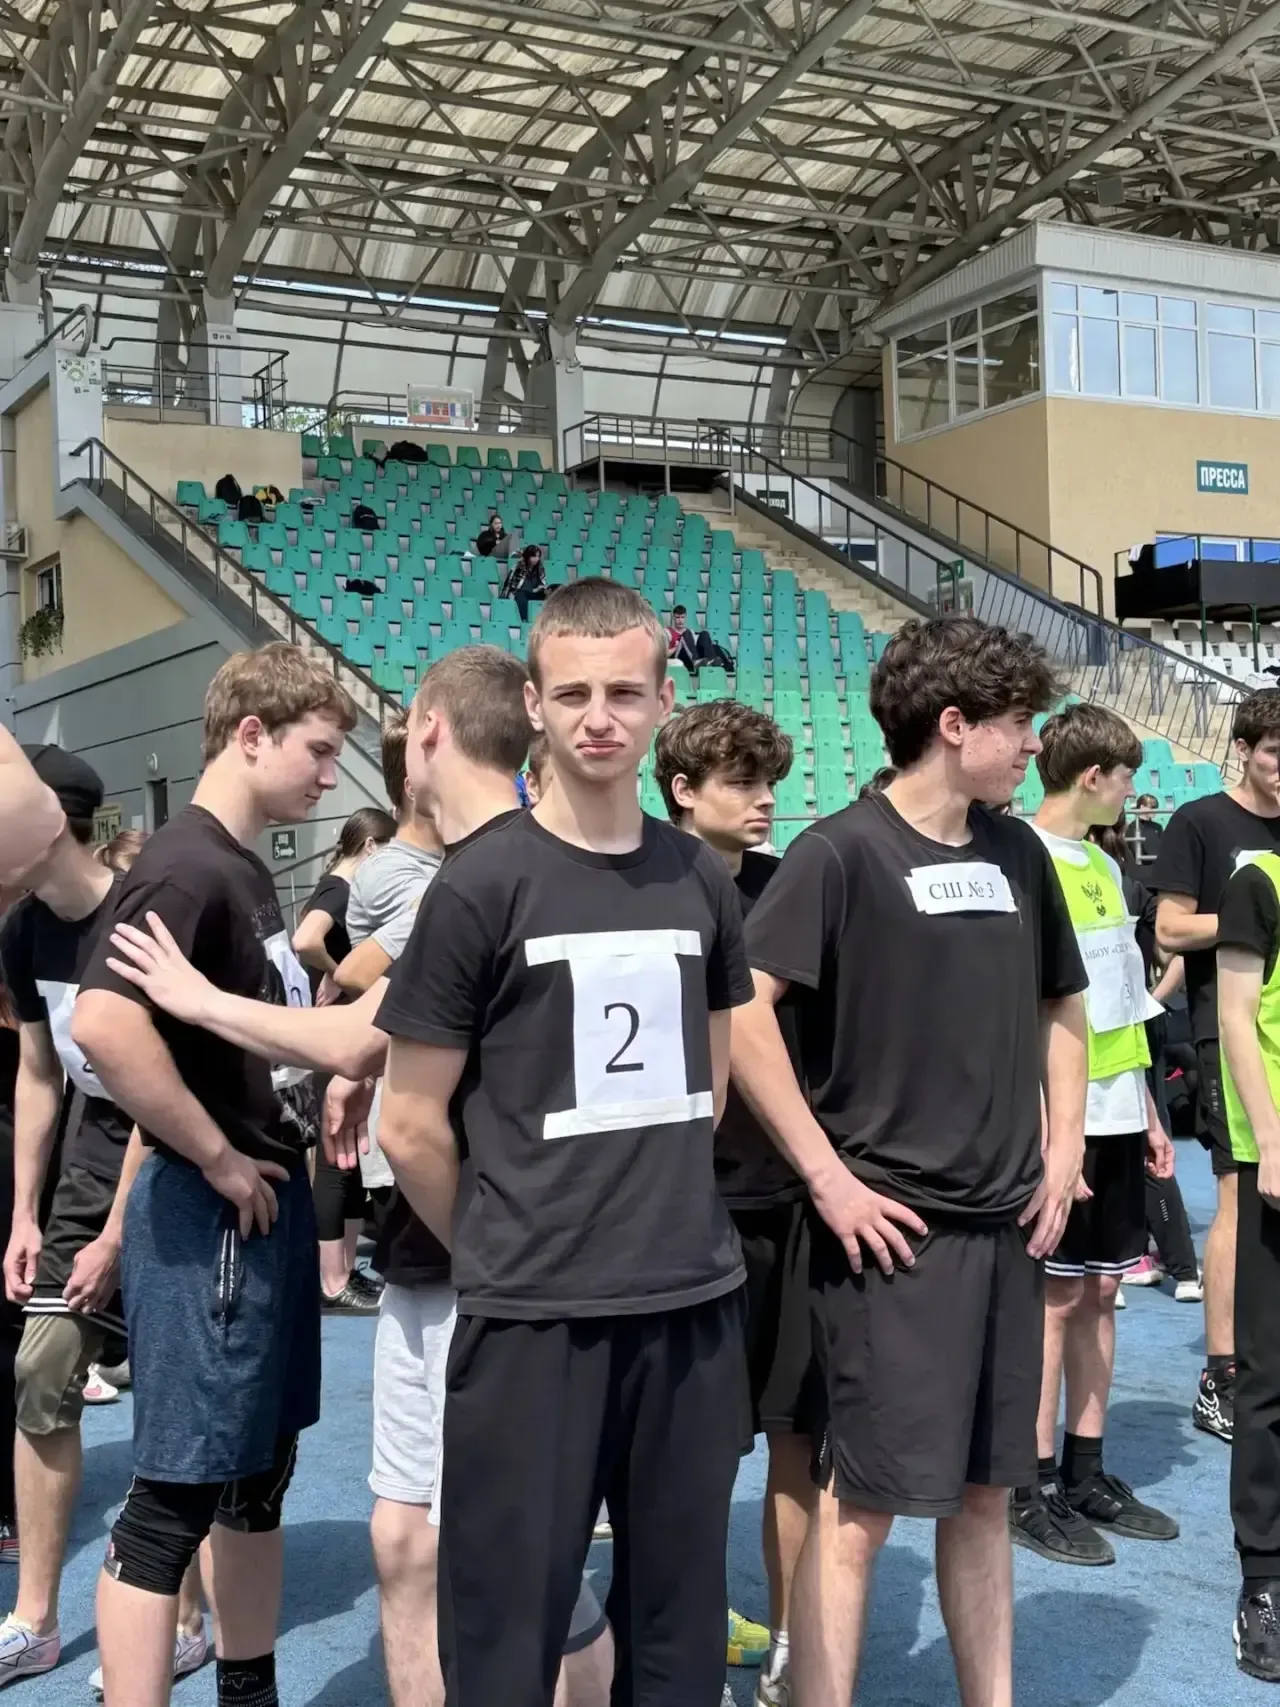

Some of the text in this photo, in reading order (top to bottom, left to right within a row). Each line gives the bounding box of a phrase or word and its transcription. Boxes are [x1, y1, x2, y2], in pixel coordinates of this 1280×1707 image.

[1200, 466, 1245, 489] ПРЕССА
[928, 881, 995, 900] СШ № 3
[604, 1002, 644, 1074] 2
